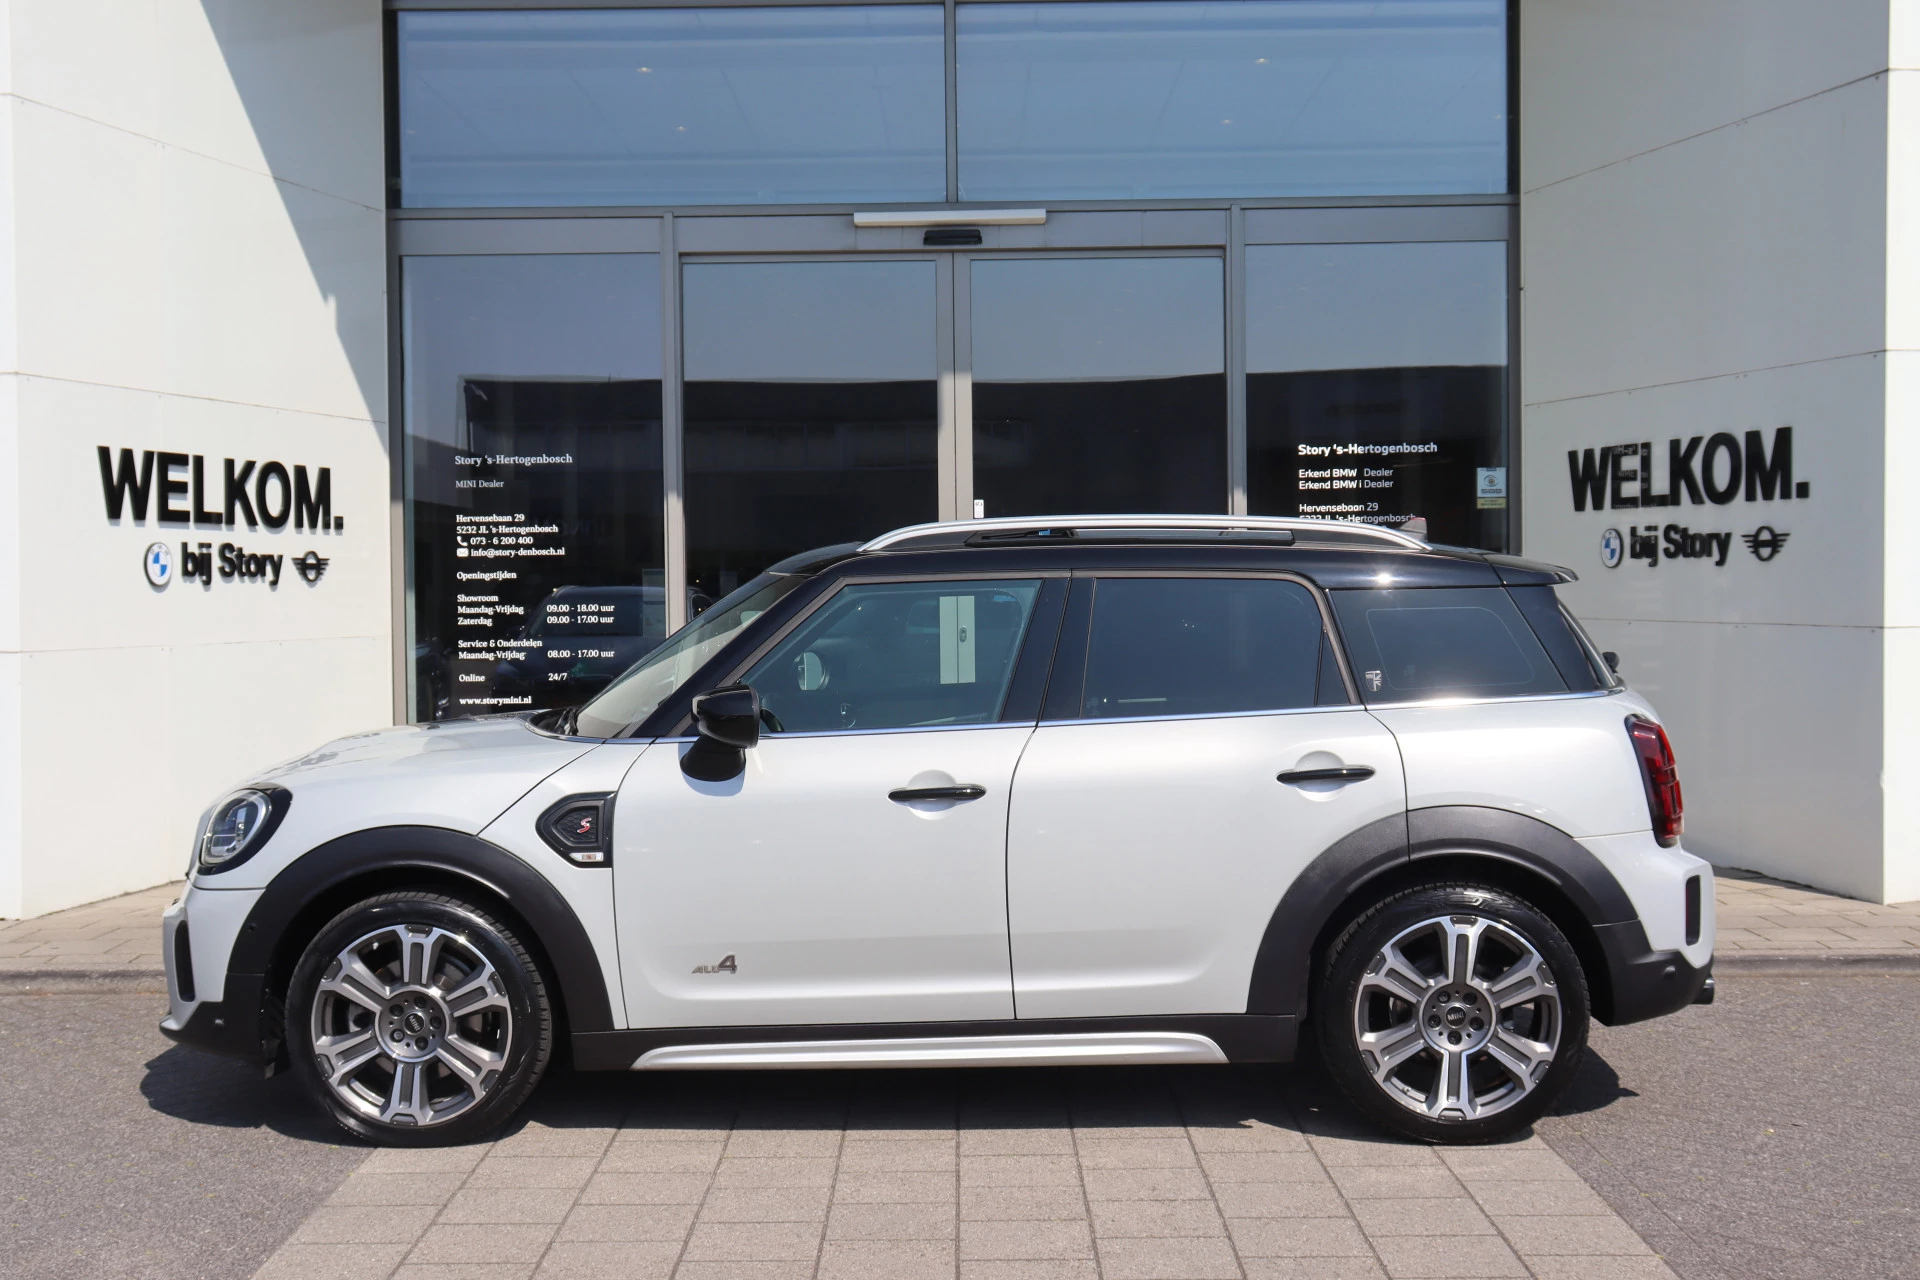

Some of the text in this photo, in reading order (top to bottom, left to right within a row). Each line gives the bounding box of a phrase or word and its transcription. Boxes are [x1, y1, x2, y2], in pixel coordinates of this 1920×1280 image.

[1298, 443, 1331, 456] Story
[455, 455, 482, 466] Story
[1299, 468, 1394, 478] Erkend BMW Dealer
[1568, 427, 1809, 511] WELKOM.
[97, 445, 344, 530] WELKOM.
[456, 479, 505, 488] MINI Dealer
[1299, 479, 1394, 489] Erkend BMW i Dealer
[1299, 502, 1379, 513] Hervensebaan 29
[456, 513, 525, 522] Hervensebaan 29
[457, 526, 477, 534] 5232
[479, 526, 489, 534] JL
[470, 537, 486, 545] 073
[493, 537, 499, 545] 6
[501, 537, 516, 545] 200
[1630, 523, 1732, 567] bij Story
[471, 547, 565, 558] info@story-denbosch.nl
[181, 542, 283, 586] bij Story
[457, 571, 517, 581] Openingstijden
[457, 594, 499, 602] Showroom
[457, 605, 524, 615] Maandag-Vrijdag
[577, 604, 599, 612] 18.00
[457, 617, 492, 626] Zaterdag
[547, 616, 569, 624] 09.00
[458, 640, 488, 648] Service
[497, 639, 543, 648] Onderdelen
[459, 651, 525, 660] Maandag-Vrijdag
[547, 650, 570, 658] 08.00
[578, 650, 599, 658] 17.00
[459, 673, 567, 682] Online 24/7
[459, 697, 532, 705] www.storymini.nl
[577, 817, 592, 833] S
